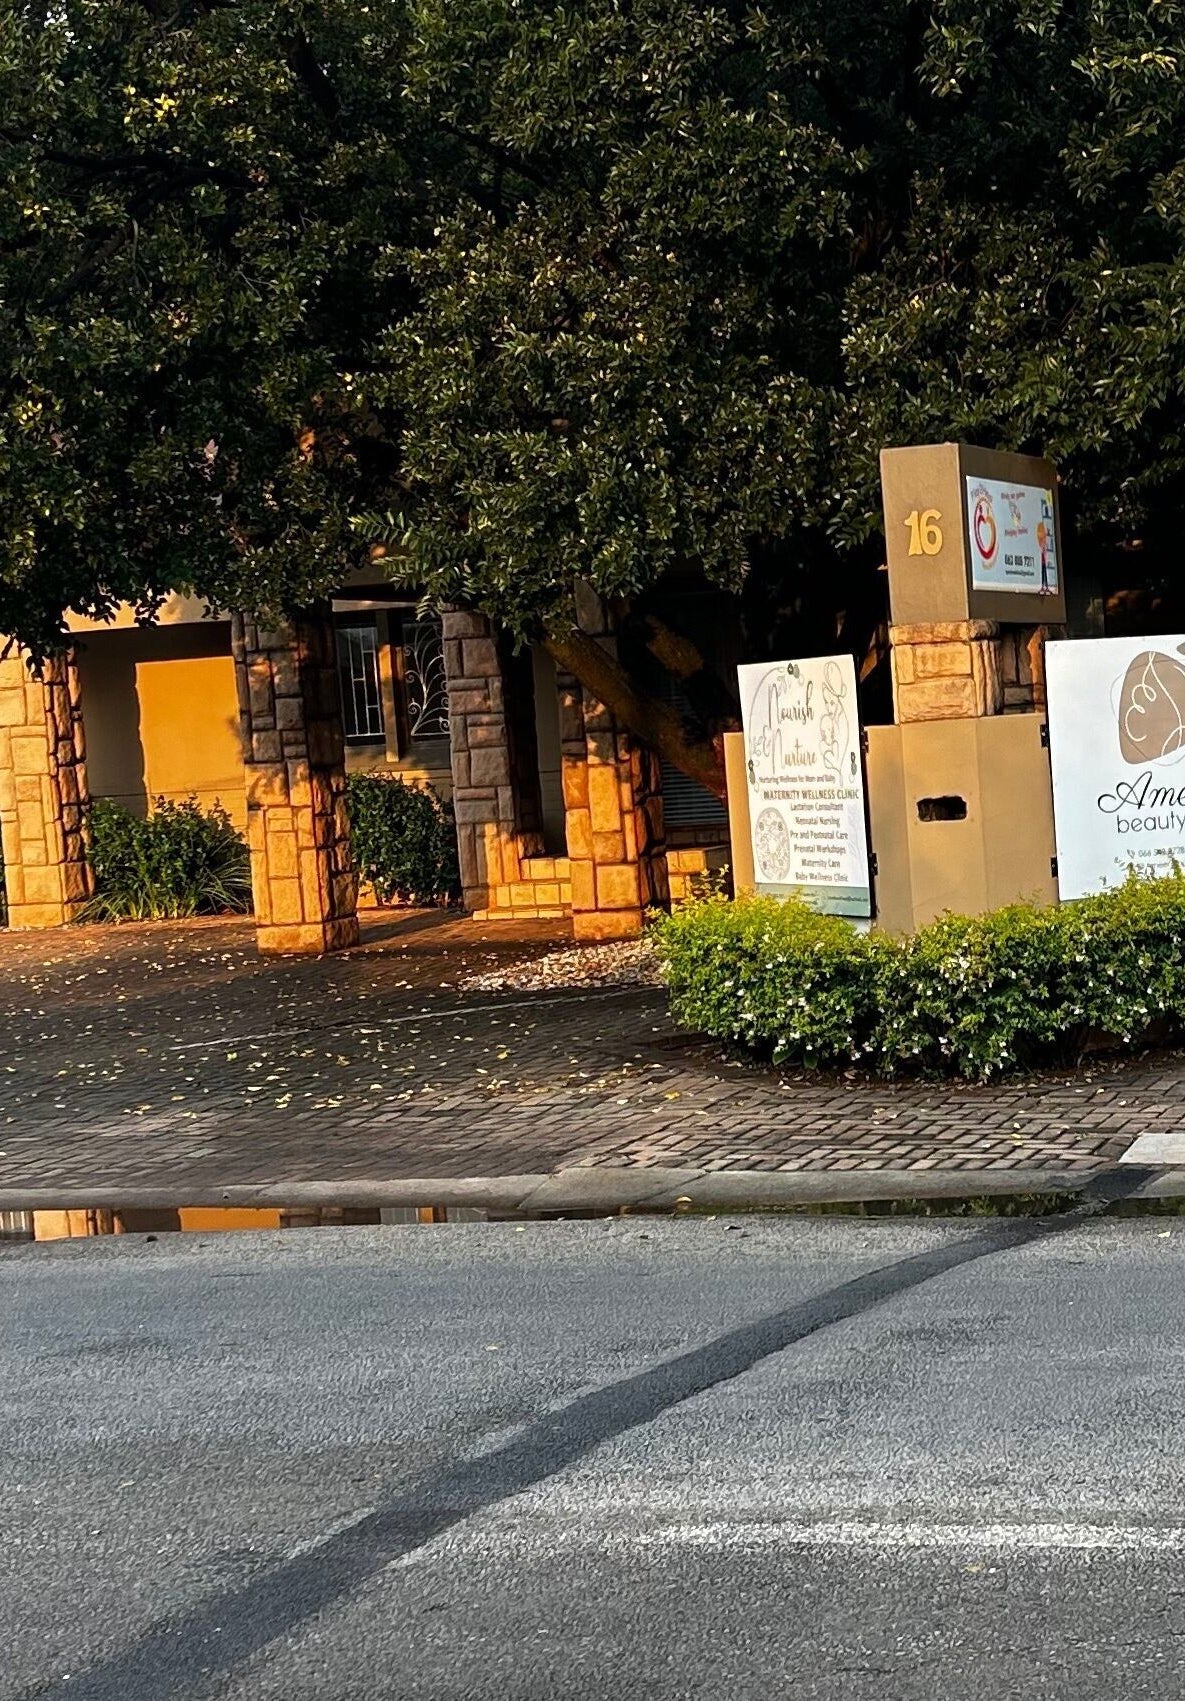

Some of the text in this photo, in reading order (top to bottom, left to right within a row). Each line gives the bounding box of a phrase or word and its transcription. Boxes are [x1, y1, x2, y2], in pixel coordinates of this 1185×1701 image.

[904, 509, 942, 556] 16
[768, 680, 814, 730] Nourish
[772, 728, 817, 774] Nurture
[763, 788, 859, 800] MATERNITY WELLNESS CLINIC
[819, 816, 840, 828] Nursing
[800, 830, 809, 839] and
[836, 830, 848, 839] Care
[828, 859, 840, 868] Care
